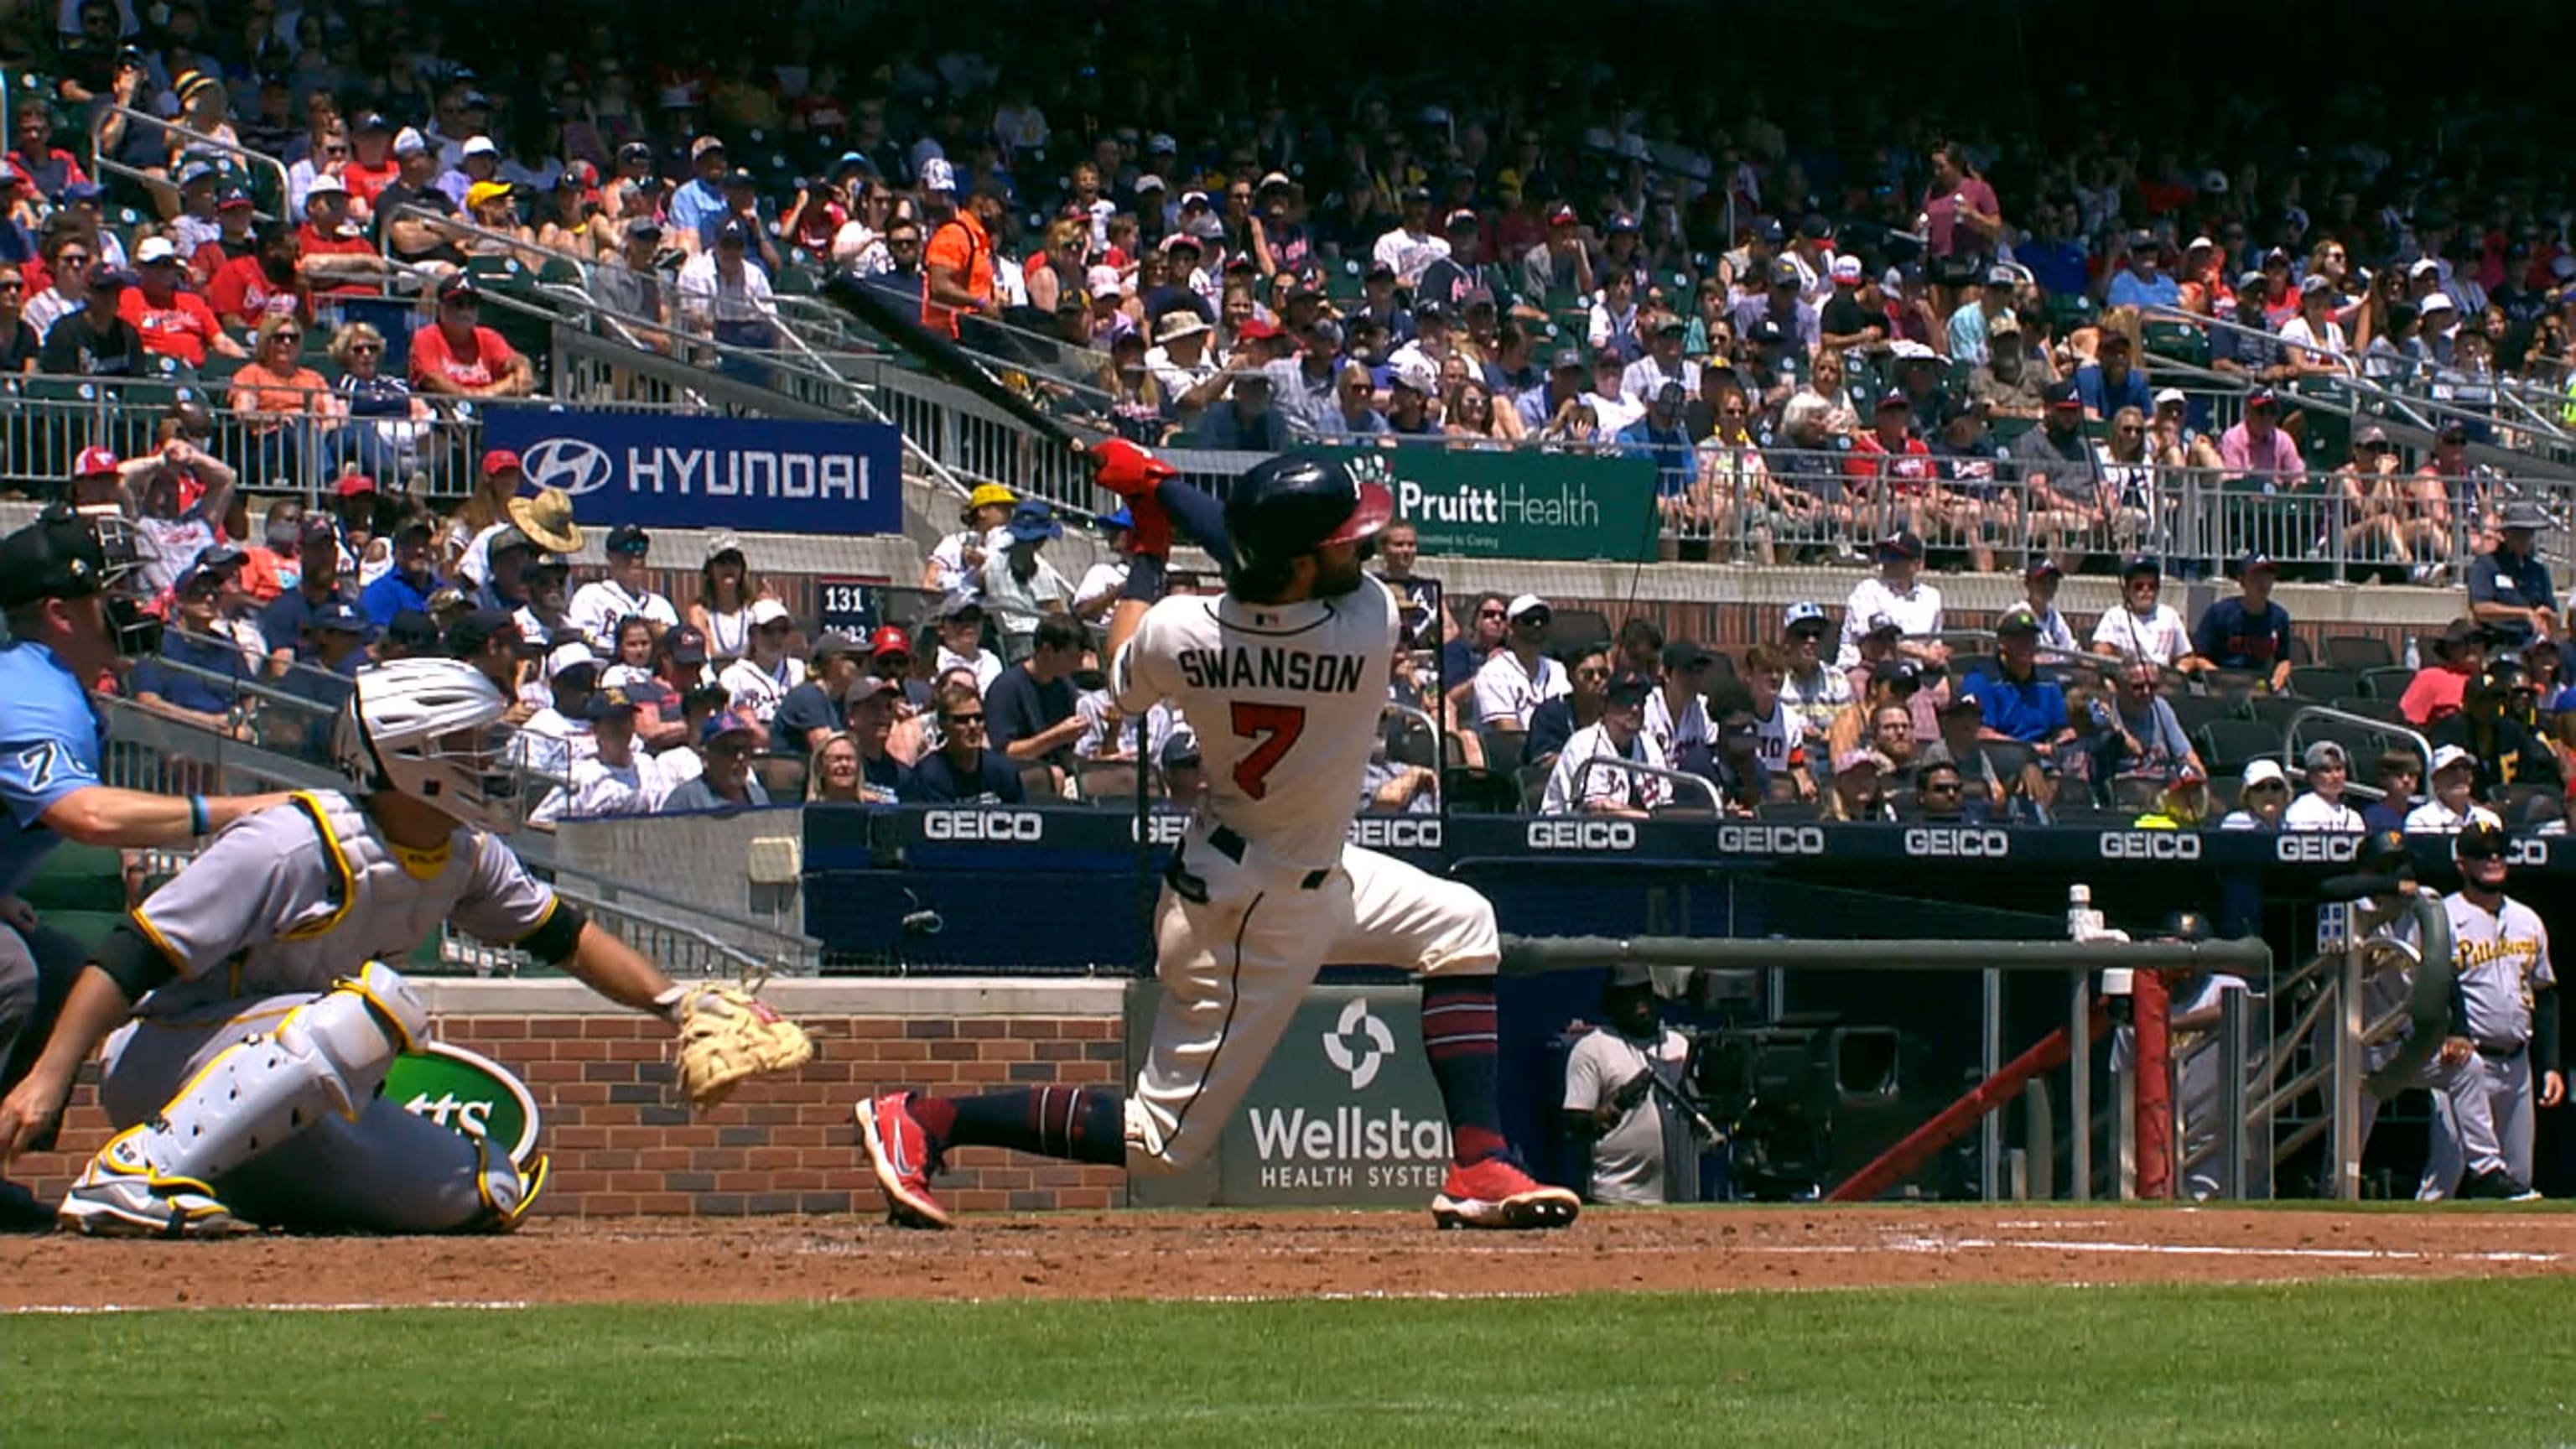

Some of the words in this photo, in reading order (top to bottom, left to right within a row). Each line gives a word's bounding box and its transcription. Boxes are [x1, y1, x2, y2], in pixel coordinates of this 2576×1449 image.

[628, 448, 870, 500] HYUNDAI
[1400, 480, 1598, 527] PruittHealth
[826, 586, 865, 612] 131
[1179, 647, 1365, 693] SWANSON
[1230, 701, 1306, 801] 7
[924, 810, 1042, 839] GEICO
[1528, 822, 1636, 849] GEICO
[1718, 827, 1825, 854] GEICO
[1904, 828, 2008, 856] GEICO
[2100, 832, 2200, 859] GEICO
[2277, 835, 2365, 861] GEIC
[1261, 1166, 1353, 1187] HEALTH
